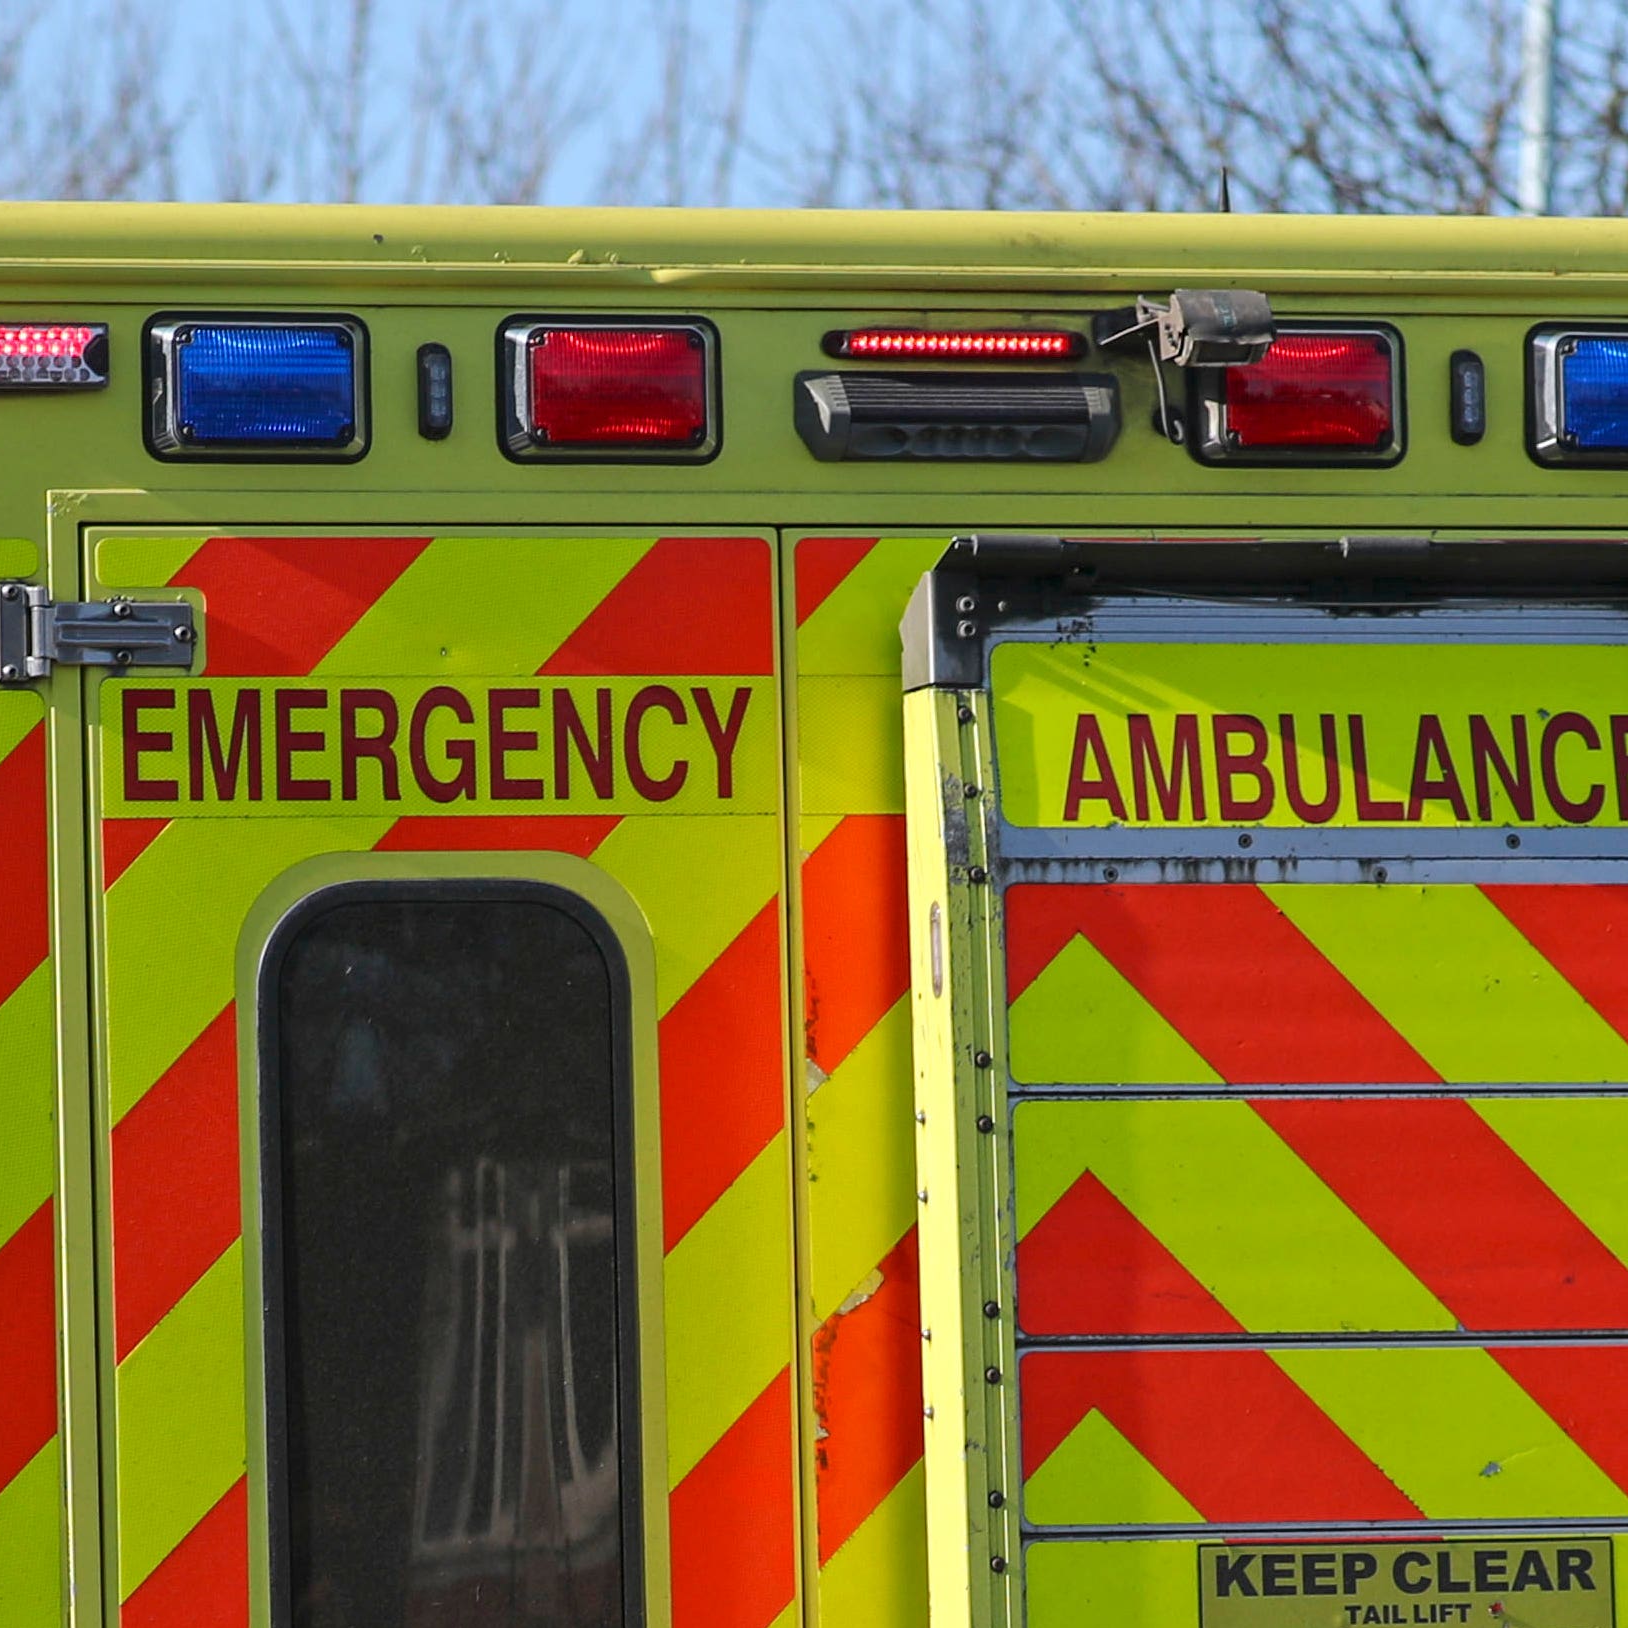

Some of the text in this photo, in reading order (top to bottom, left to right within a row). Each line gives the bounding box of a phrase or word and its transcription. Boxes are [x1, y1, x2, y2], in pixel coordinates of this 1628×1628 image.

[122, 685, 753, 803] EMERGENCY
[1215, 1549, 1596, 1597] KEEP CLEAR
[1345, 1603, 1472, 1625] TAIL LIFT
